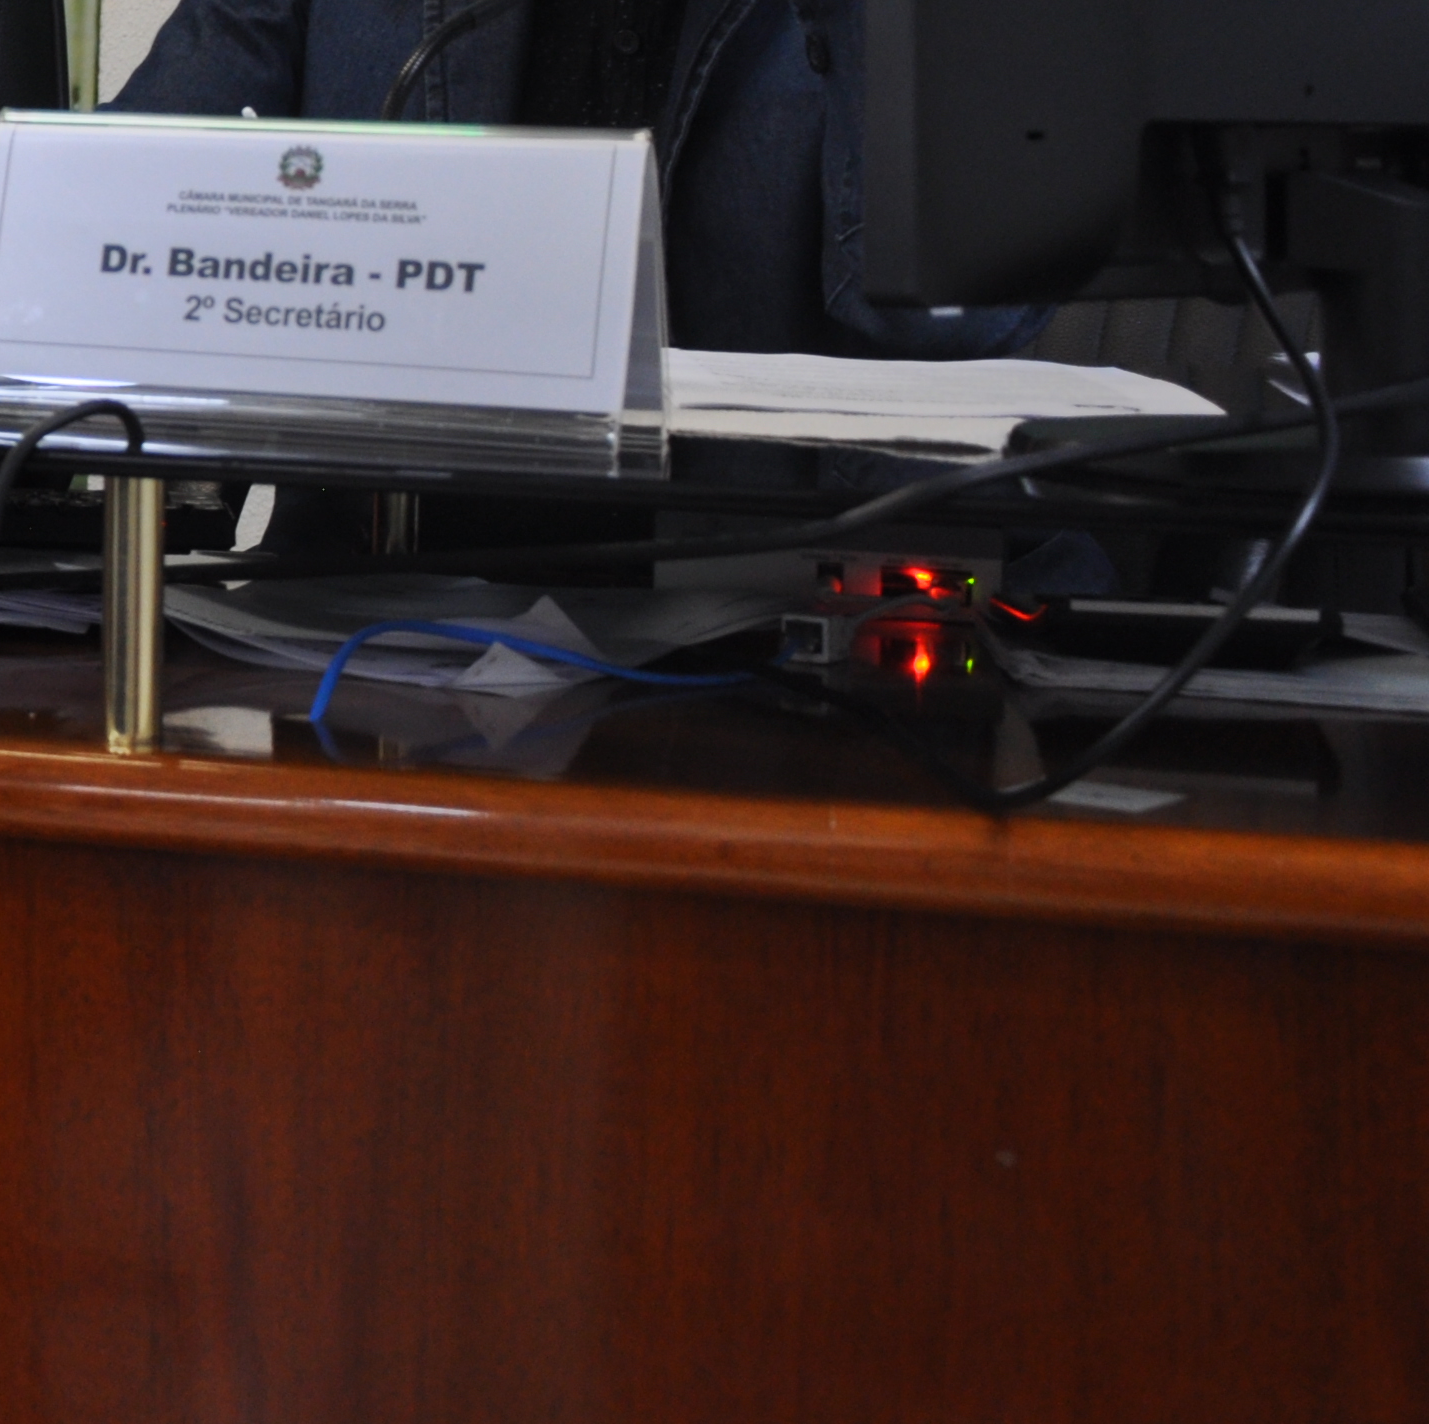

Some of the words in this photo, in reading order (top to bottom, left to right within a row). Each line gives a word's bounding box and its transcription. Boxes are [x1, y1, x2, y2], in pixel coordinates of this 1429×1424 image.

[101, 243, 153, 275] Dr.
[168, 246, 355, 288] Bandeira
[396, 258, 486, 293] PDT
[223, 294, 387, 334] Secretário
